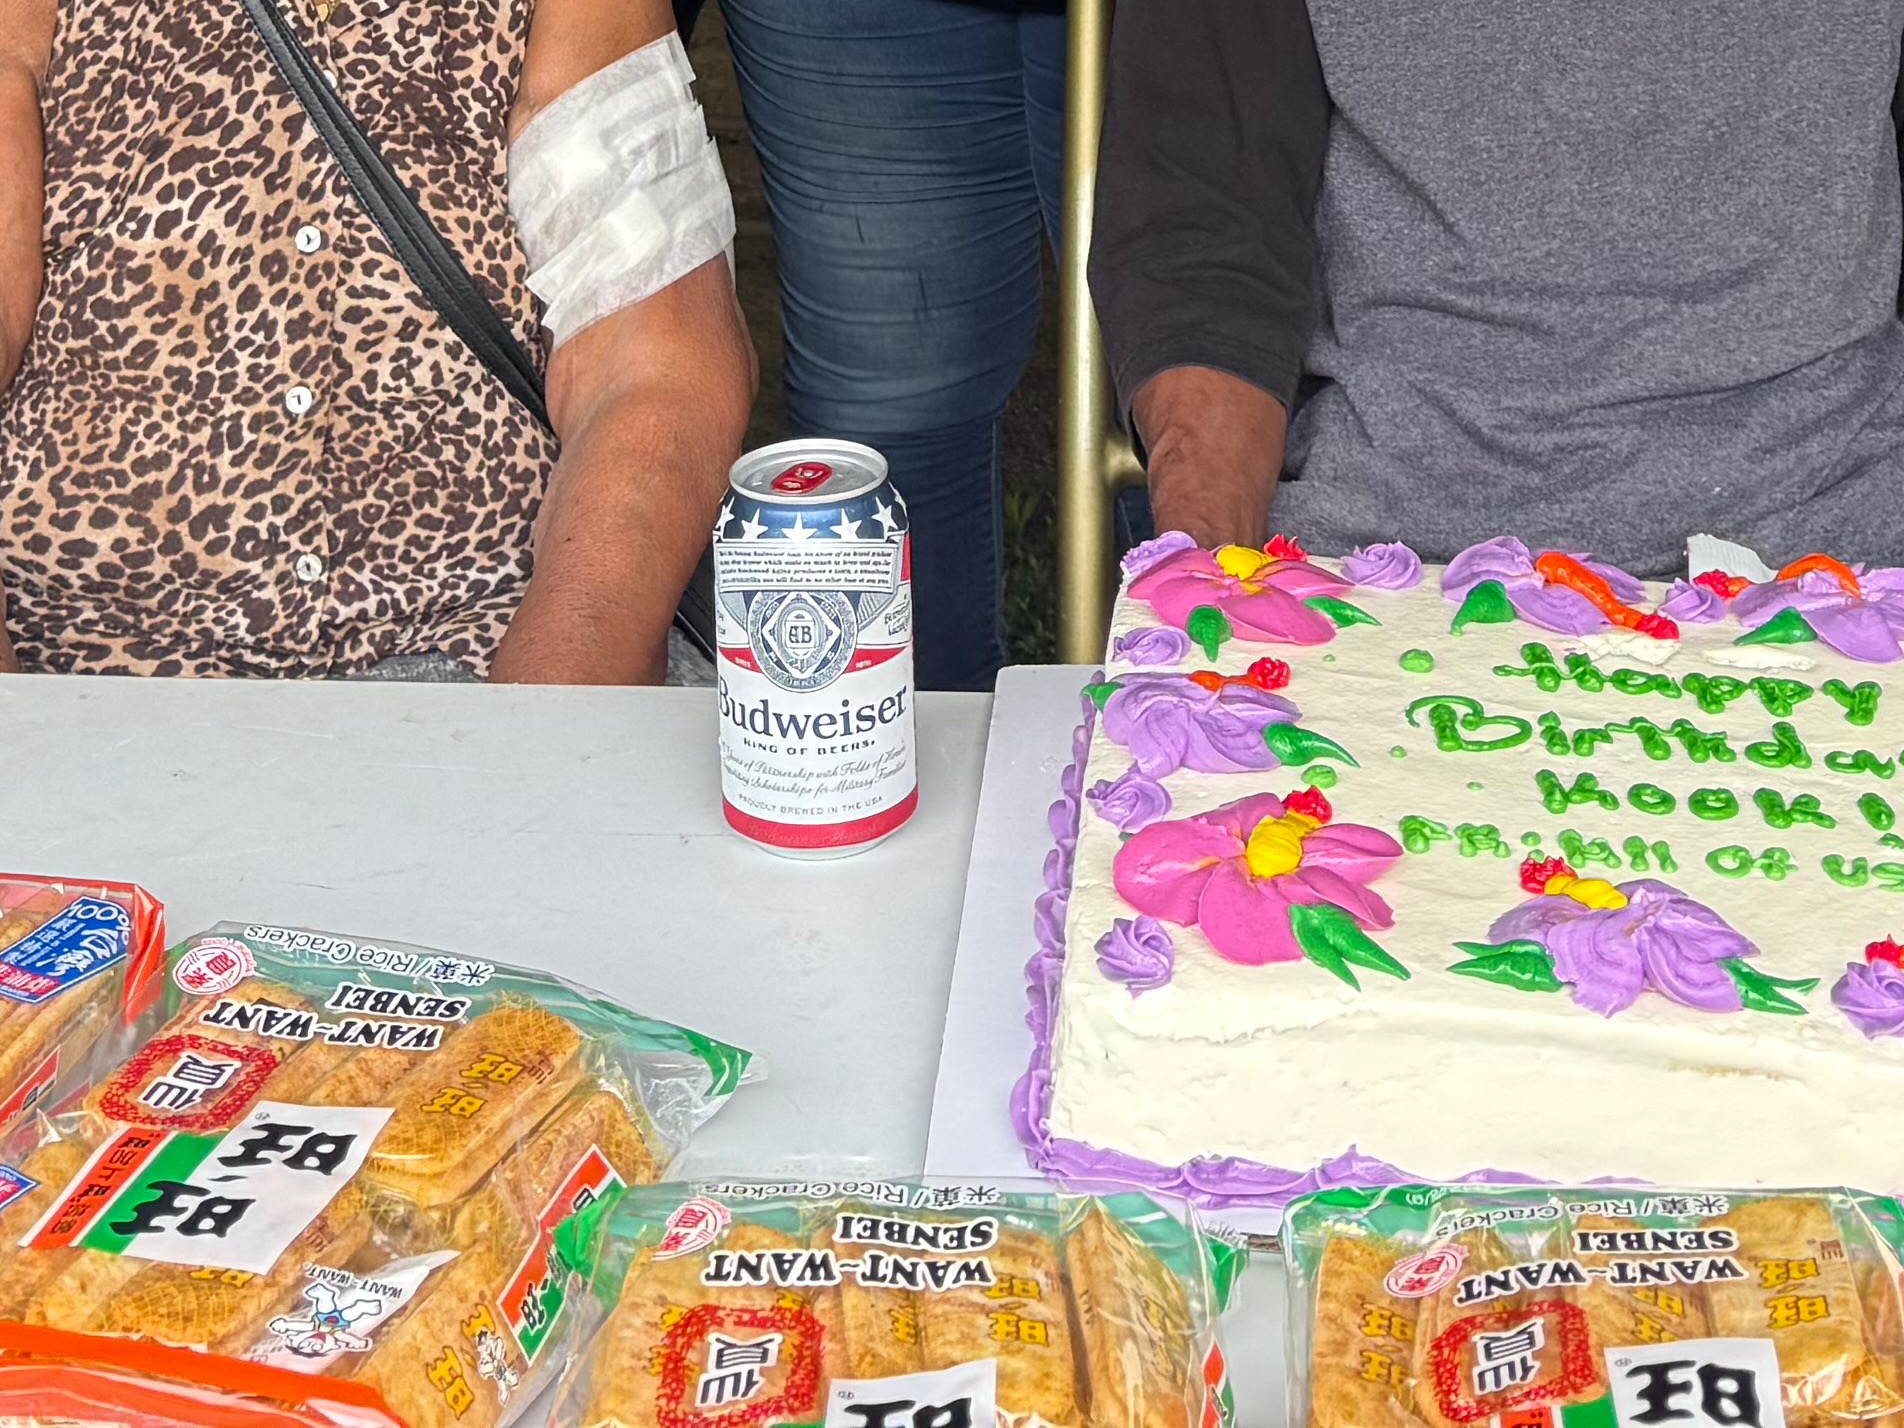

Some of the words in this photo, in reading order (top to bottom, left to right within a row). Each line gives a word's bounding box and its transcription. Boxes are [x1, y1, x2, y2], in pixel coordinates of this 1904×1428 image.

[719, 675, 908, 740] Budweiser
[743, 737, 778, 754] KING
[247, 925, 353, 960] Crackers
[359, 947, 416, 974] Rice
[330, 984, 467, 1021] SENBEI
[704, 1182, 837, 1199] Crackers
[842, 1181, 907, 1206] Rice
[1568, 1199, 1637, 1218] Rice
[837, 1215, 995, 1250] SENBEI
[1575, 1229, 1736, 1253] SENBEI
